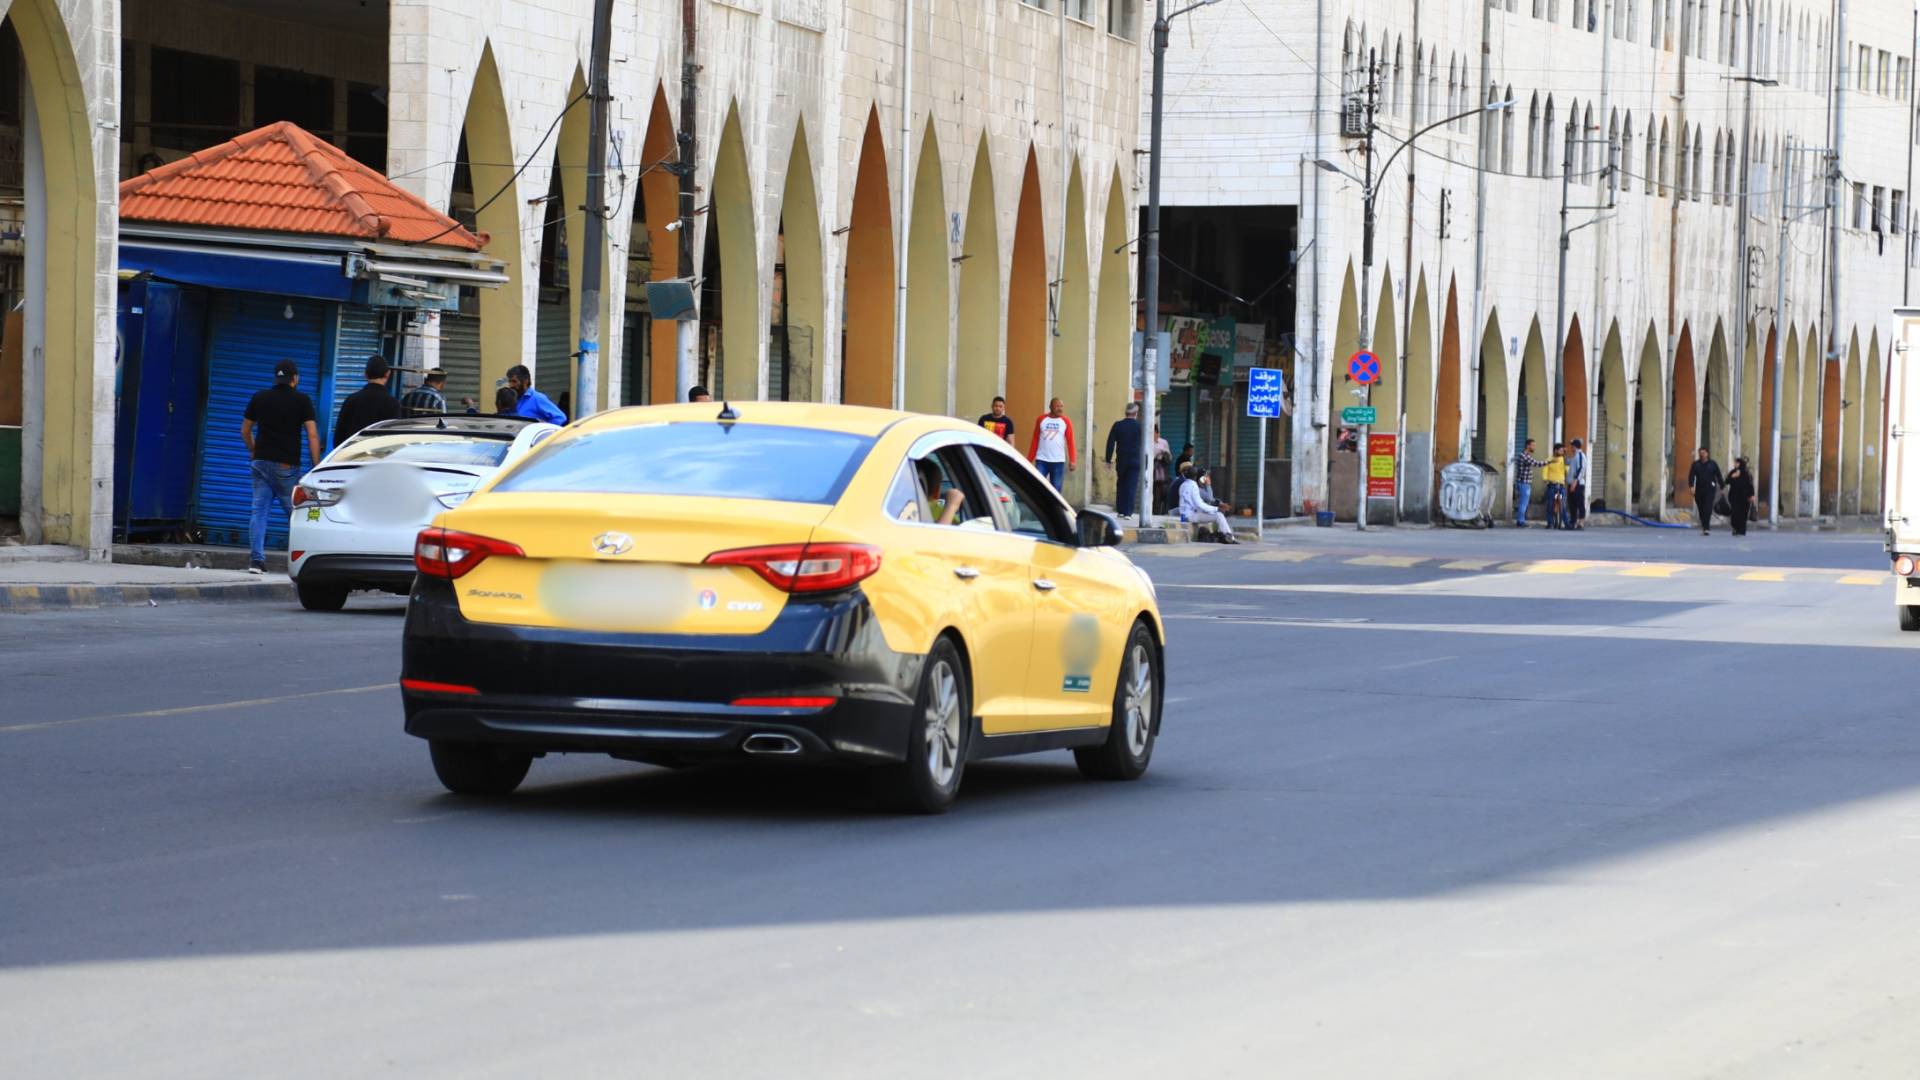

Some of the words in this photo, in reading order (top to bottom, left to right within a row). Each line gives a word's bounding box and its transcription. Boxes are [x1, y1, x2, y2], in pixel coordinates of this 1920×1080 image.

[1255, 371, 1276, 382] موقف
[1252, 382, 1278, 392] سرفيس
[467, 589, 522, 600] SONATA
